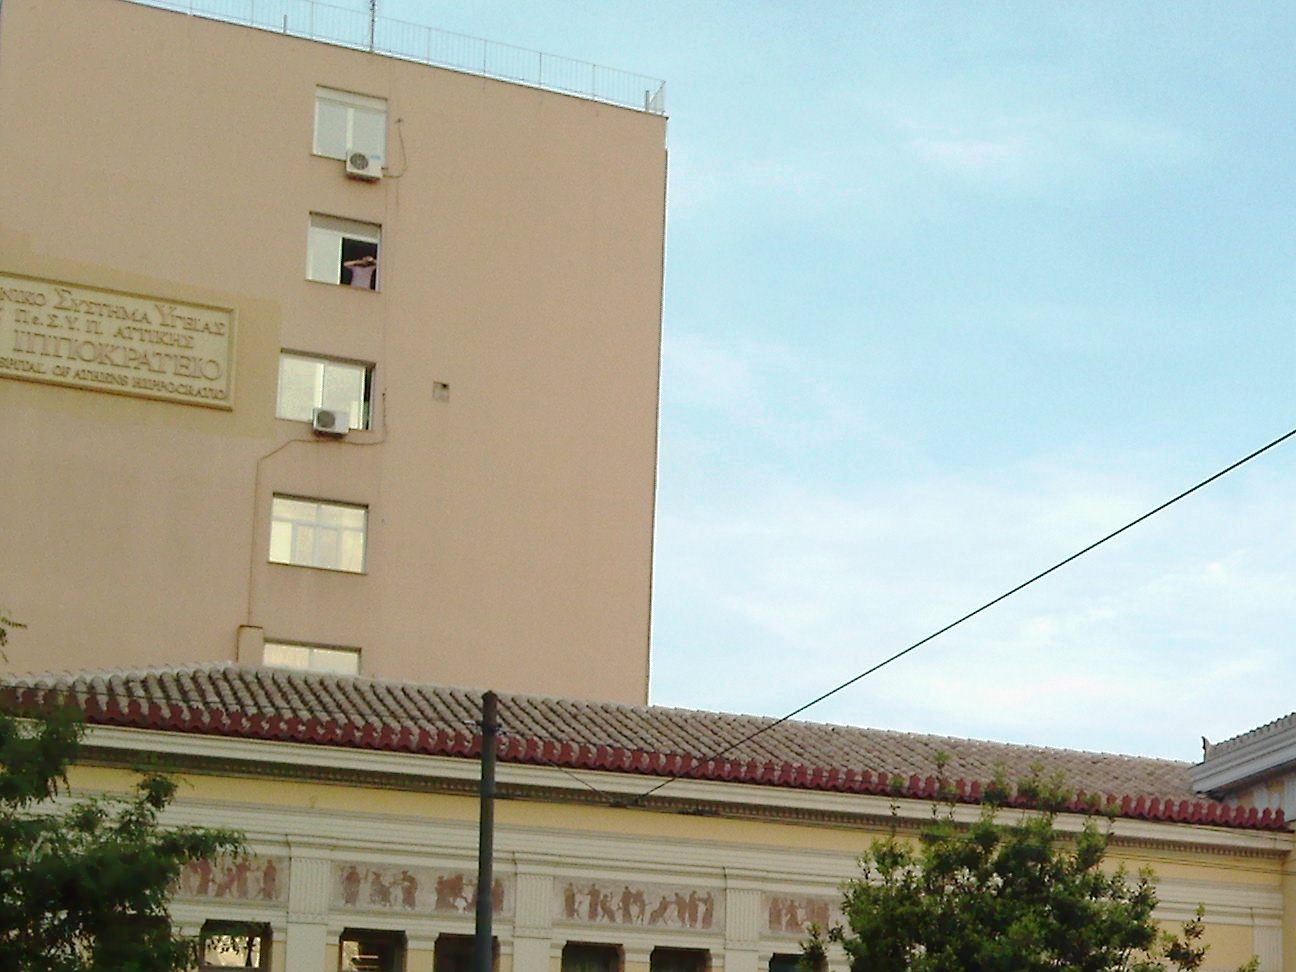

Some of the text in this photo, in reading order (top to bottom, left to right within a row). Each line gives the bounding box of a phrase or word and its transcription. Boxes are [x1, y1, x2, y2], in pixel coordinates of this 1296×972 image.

[53, 287, 152, 325] ΣΥΣΤΗΜΑ
[113, 326, 195, 350] ΑΤΤΙΚΗΣ
[13, 329, 222, 382] ΙΠΠΟΚΡΑΤΕΙΟ
[53, 364, 72, 378] OF
[73, 369, 129, 387] ATHENS
